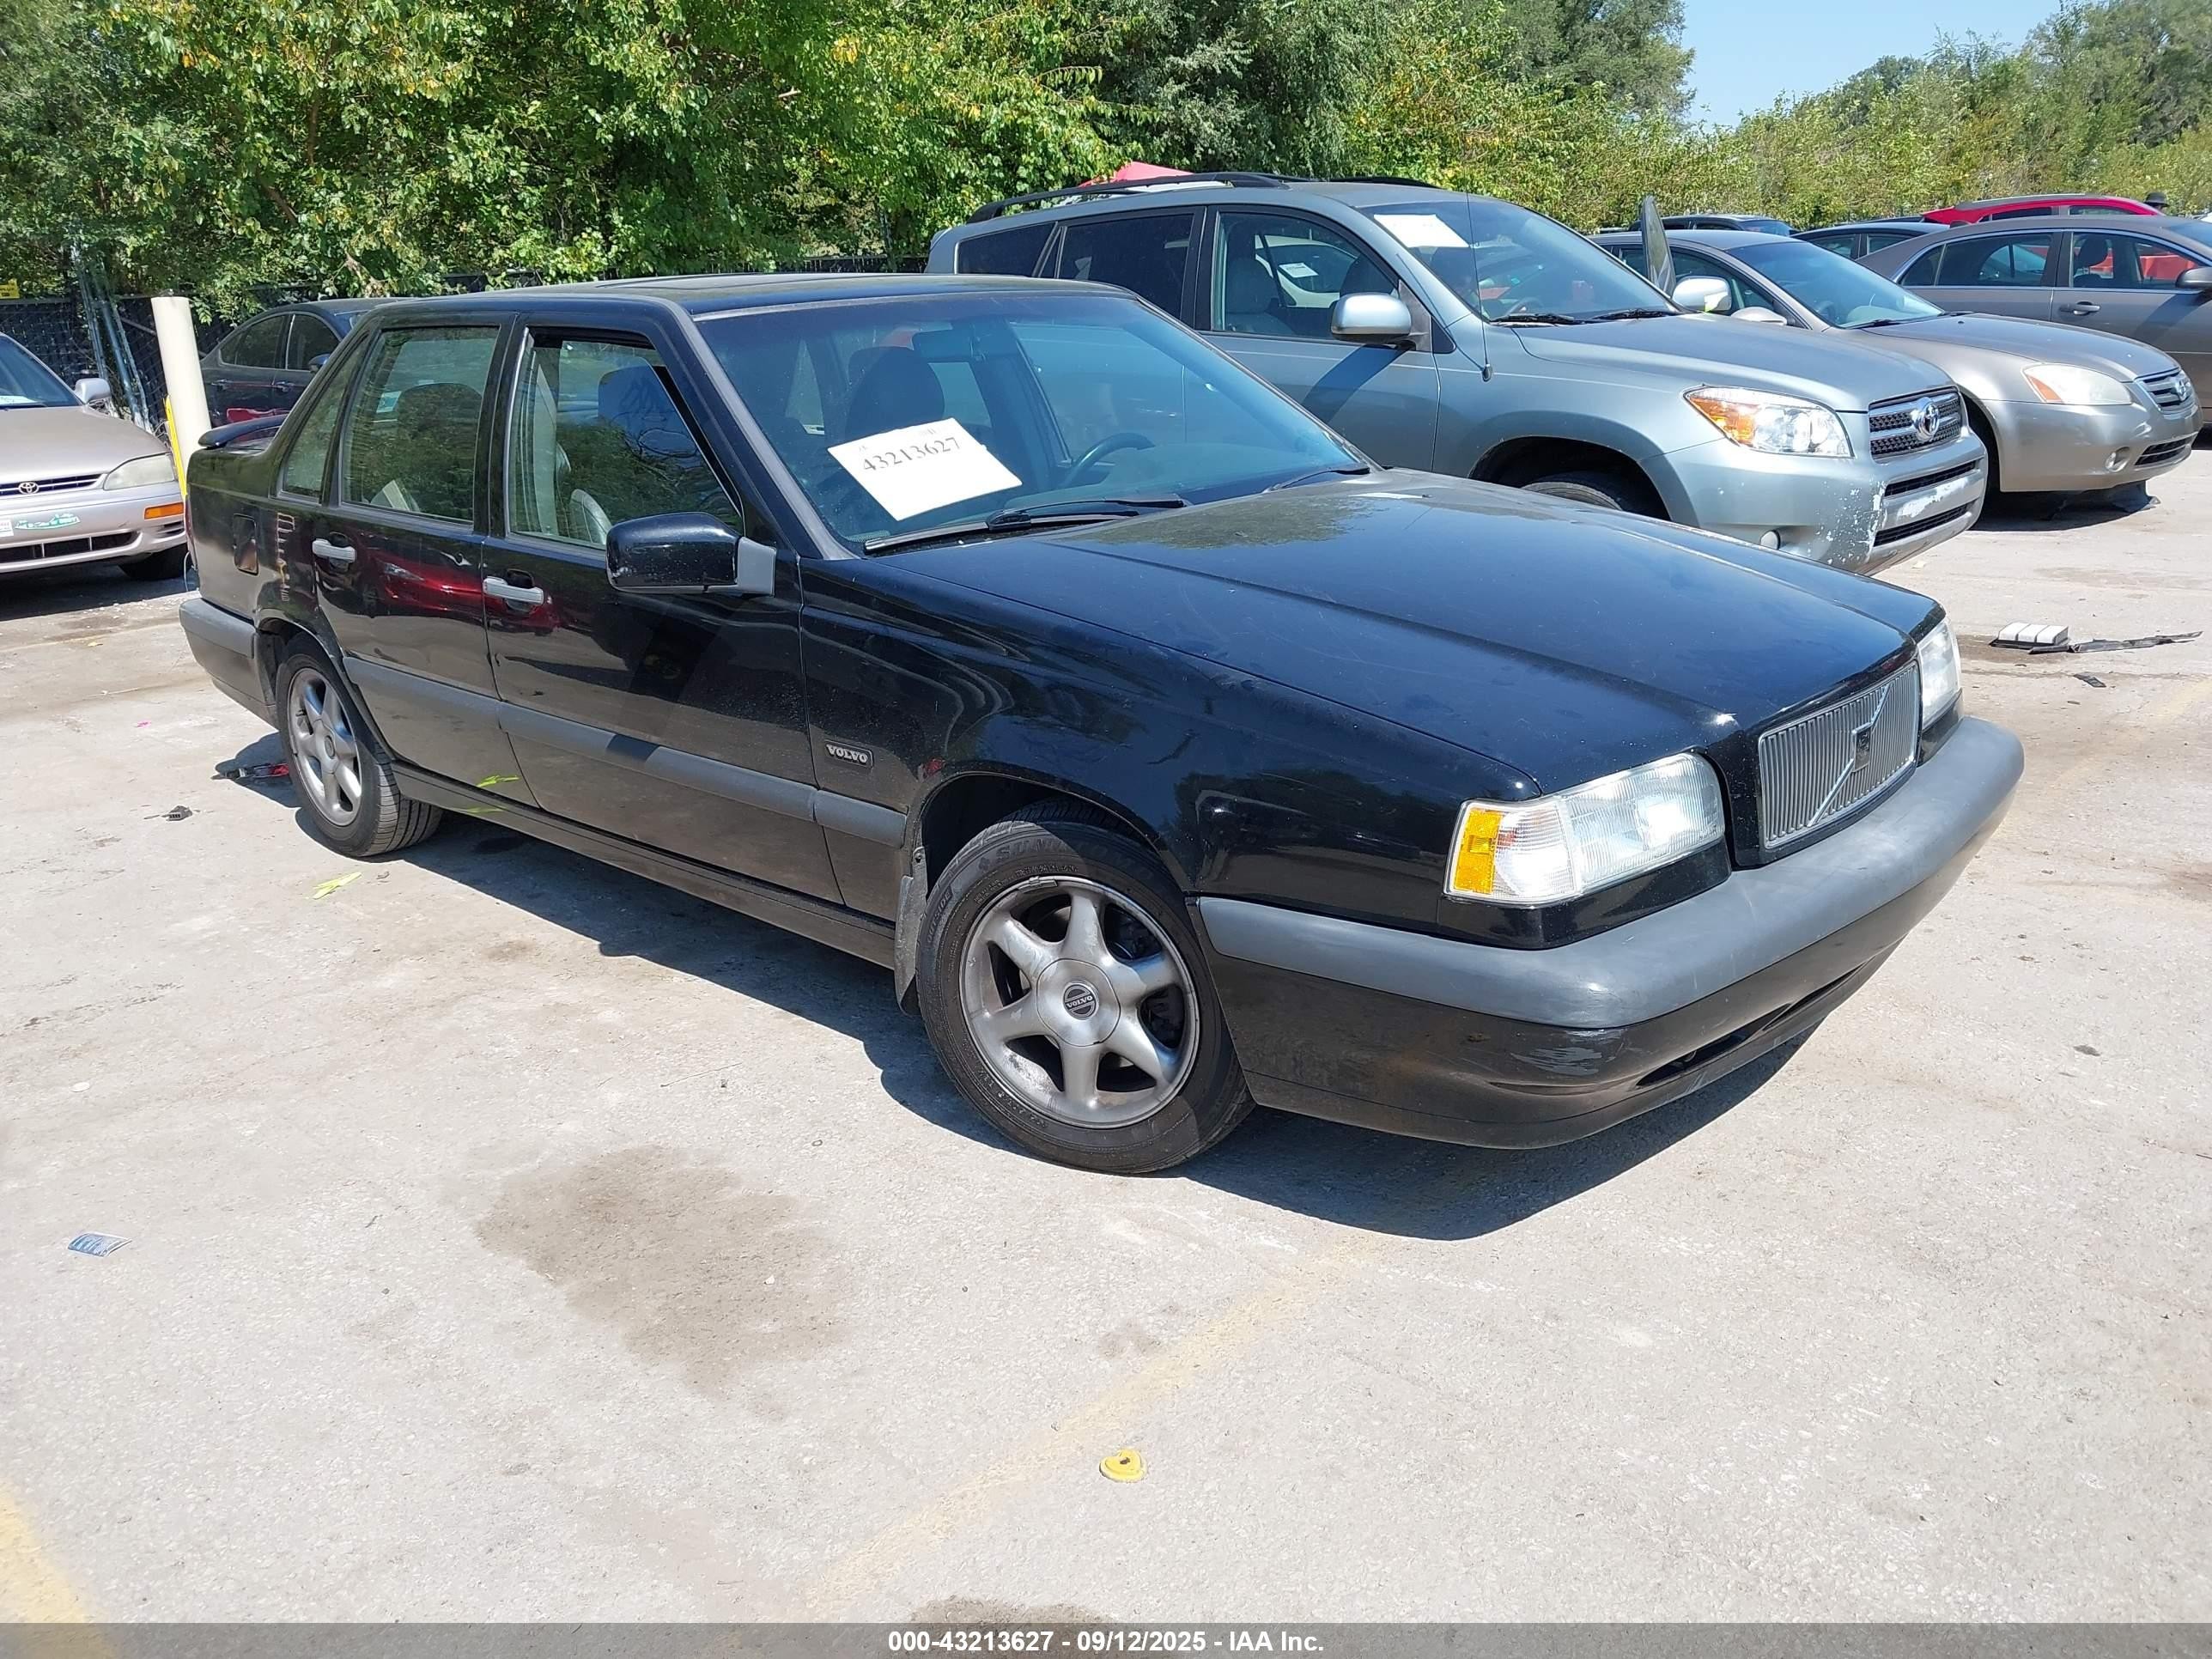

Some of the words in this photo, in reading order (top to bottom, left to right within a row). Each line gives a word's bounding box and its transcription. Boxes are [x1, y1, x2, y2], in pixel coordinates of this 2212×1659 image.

[863, 436, 961, 471] 43213627
[825, 744, 869, 763] VOLVO
[1066, 995, 1093, 1008] VOLVO
